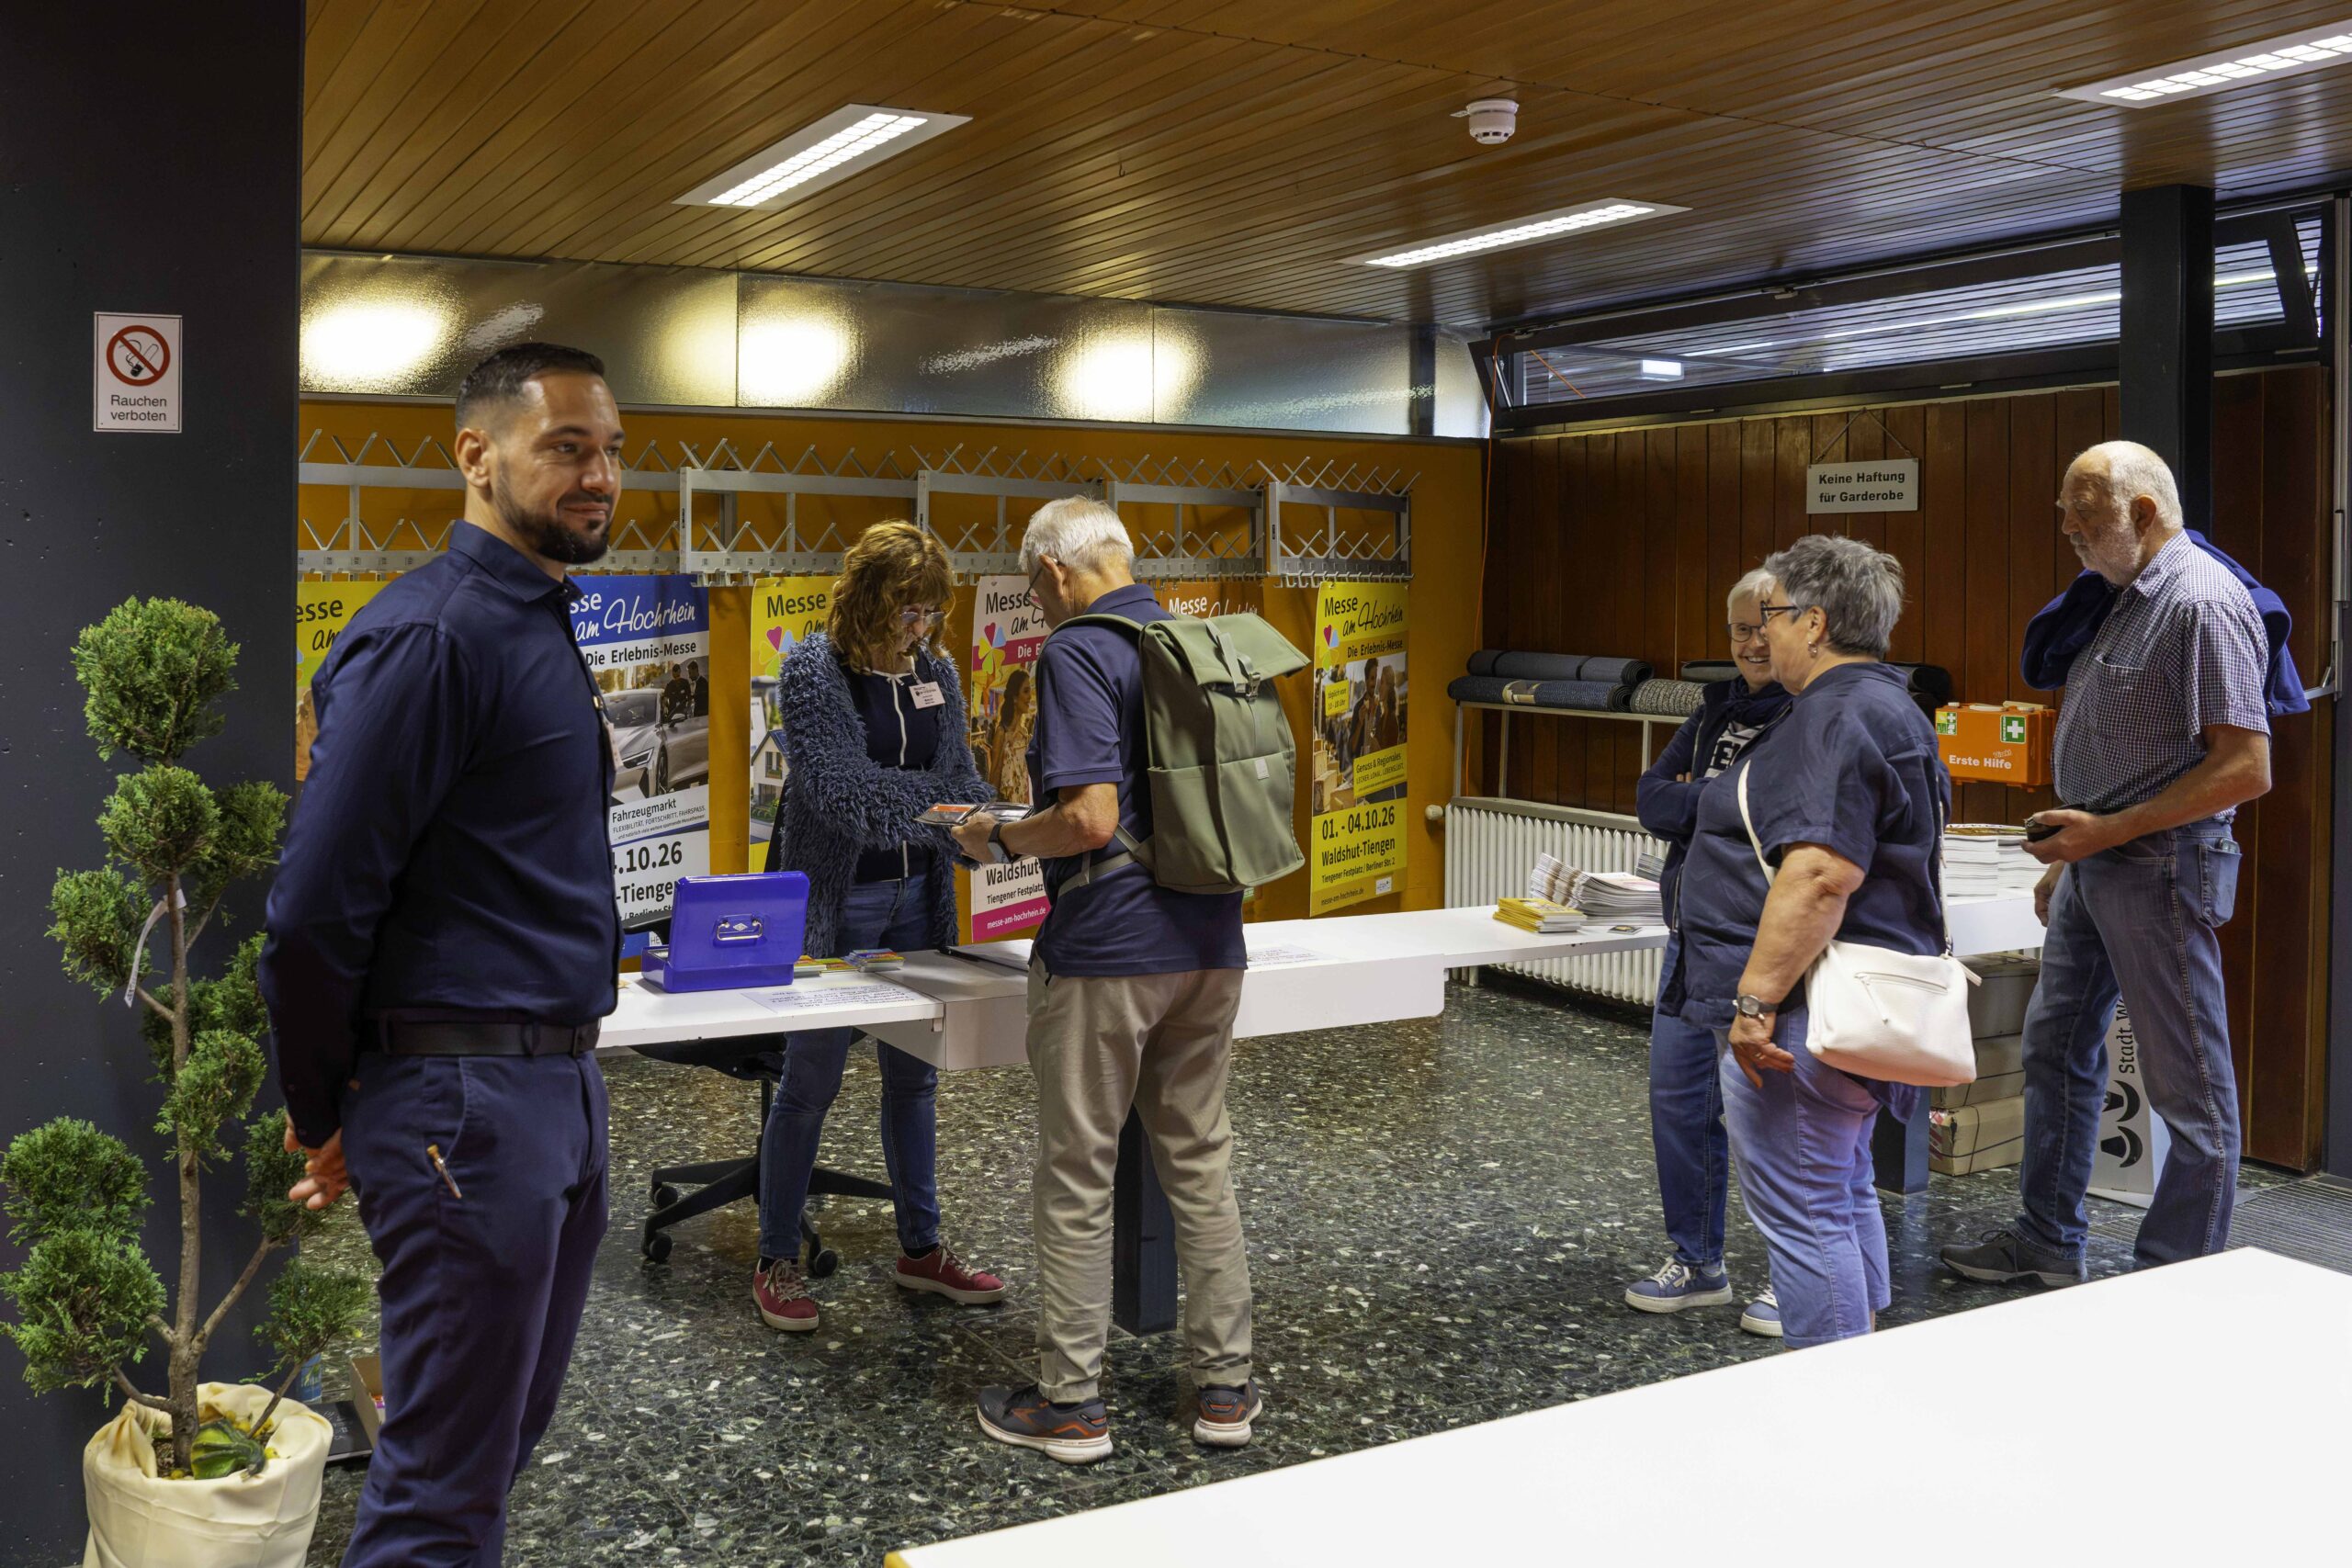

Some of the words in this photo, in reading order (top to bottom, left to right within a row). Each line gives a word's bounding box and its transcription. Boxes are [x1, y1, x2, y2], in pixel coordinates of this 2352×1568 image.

[110, 394, 167, 407] Rauchen
[110, 410, 167, 422] verboten
[1819, 474, 1852, 484] Keine
[1856, 471, 1905, 483] Haftung
[1819, 492, 1836, 502] für
[1839, 490, 1904, 502] Garderobe
[294, 600, 343, 623] esse
[570, 592, 602, 615] sse
[766, 592, 826, 618] Messe
[985, 592, 1030, 615] Messe
[1169, 596, 1207, 615] Messe
[1324, 596, 1358, 618] Messe
[575, 620, 600, 641] am
[603, 595, 695, 634] Hochrhein
[1011, 616, 1029, 636] am
[1342, 619, 1356, 637] am
[1357, 599, 1403, 631] Hochrhein
[585, 651, 605, 666] Die
[611, 641, 696, 663] Erlebnis-Messe
[1017, 644, 1032, 659] Die
[1347, 646, 1358, 659] Die
[1361, 639, 1403, 656] Erlebnis-Messe
[1949, 754, 1980, 766] Erste
[1984, 758, 2012, 769] Hilfe
[612, 798, 677, 824] Fahrzeugmarkt
[1322, 818, 1339, 840] 01.
[1348, 806, 1395, 834] 04.10.26
[1322, 838, 1396, 866] Waldshut-Tiengen
[1321, 872, 1343, 884] Tiengener
[1343, 864, 1363, 877] Festplatz
[1366, 861, 1384, 872] Berliner
[987, 891, 1016, 905] Tiengener
[1017, 883, 1044, 897] Festplatz
[987, 906, 1046, 930] messe-am-hochrhein.de
